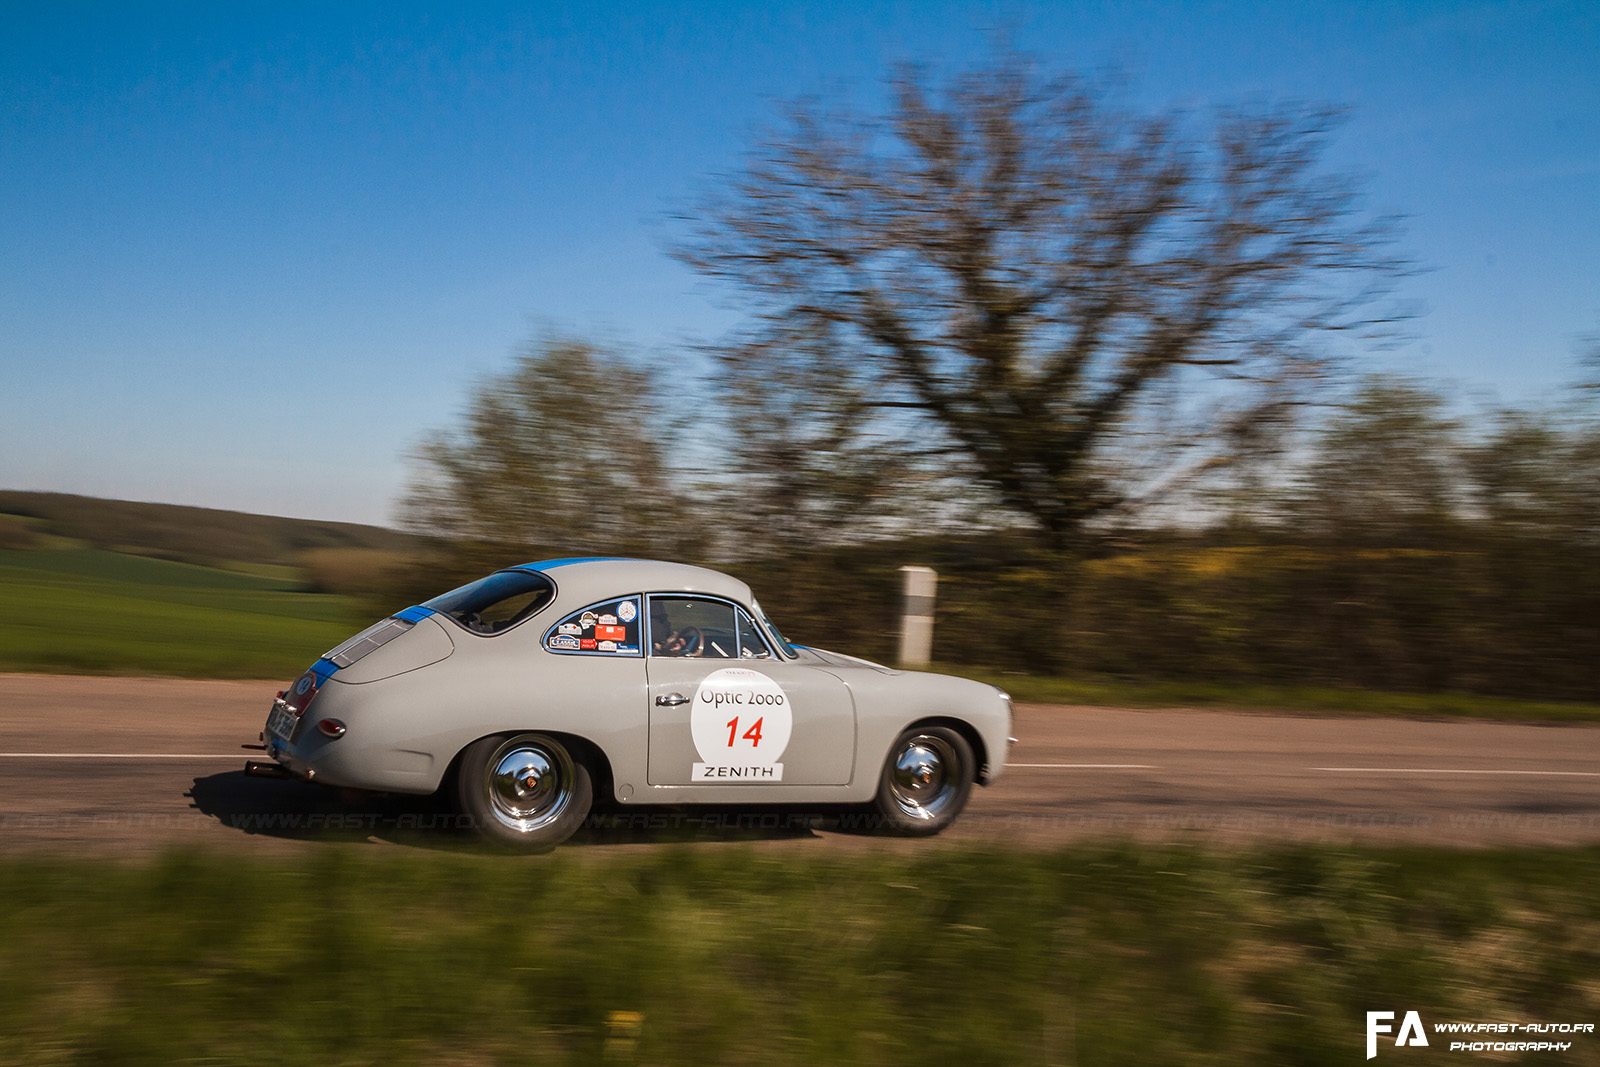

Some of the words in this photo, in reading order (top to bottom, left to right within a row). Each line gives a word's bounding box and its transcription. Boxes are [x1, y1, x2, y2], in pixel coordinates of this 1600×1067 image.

[700, 689, 743, 709] Optic
[748, 690, 784, 706] 2000
[726, 716, 764, 747] 14
[704, 766, 774, 778] ZENITH
